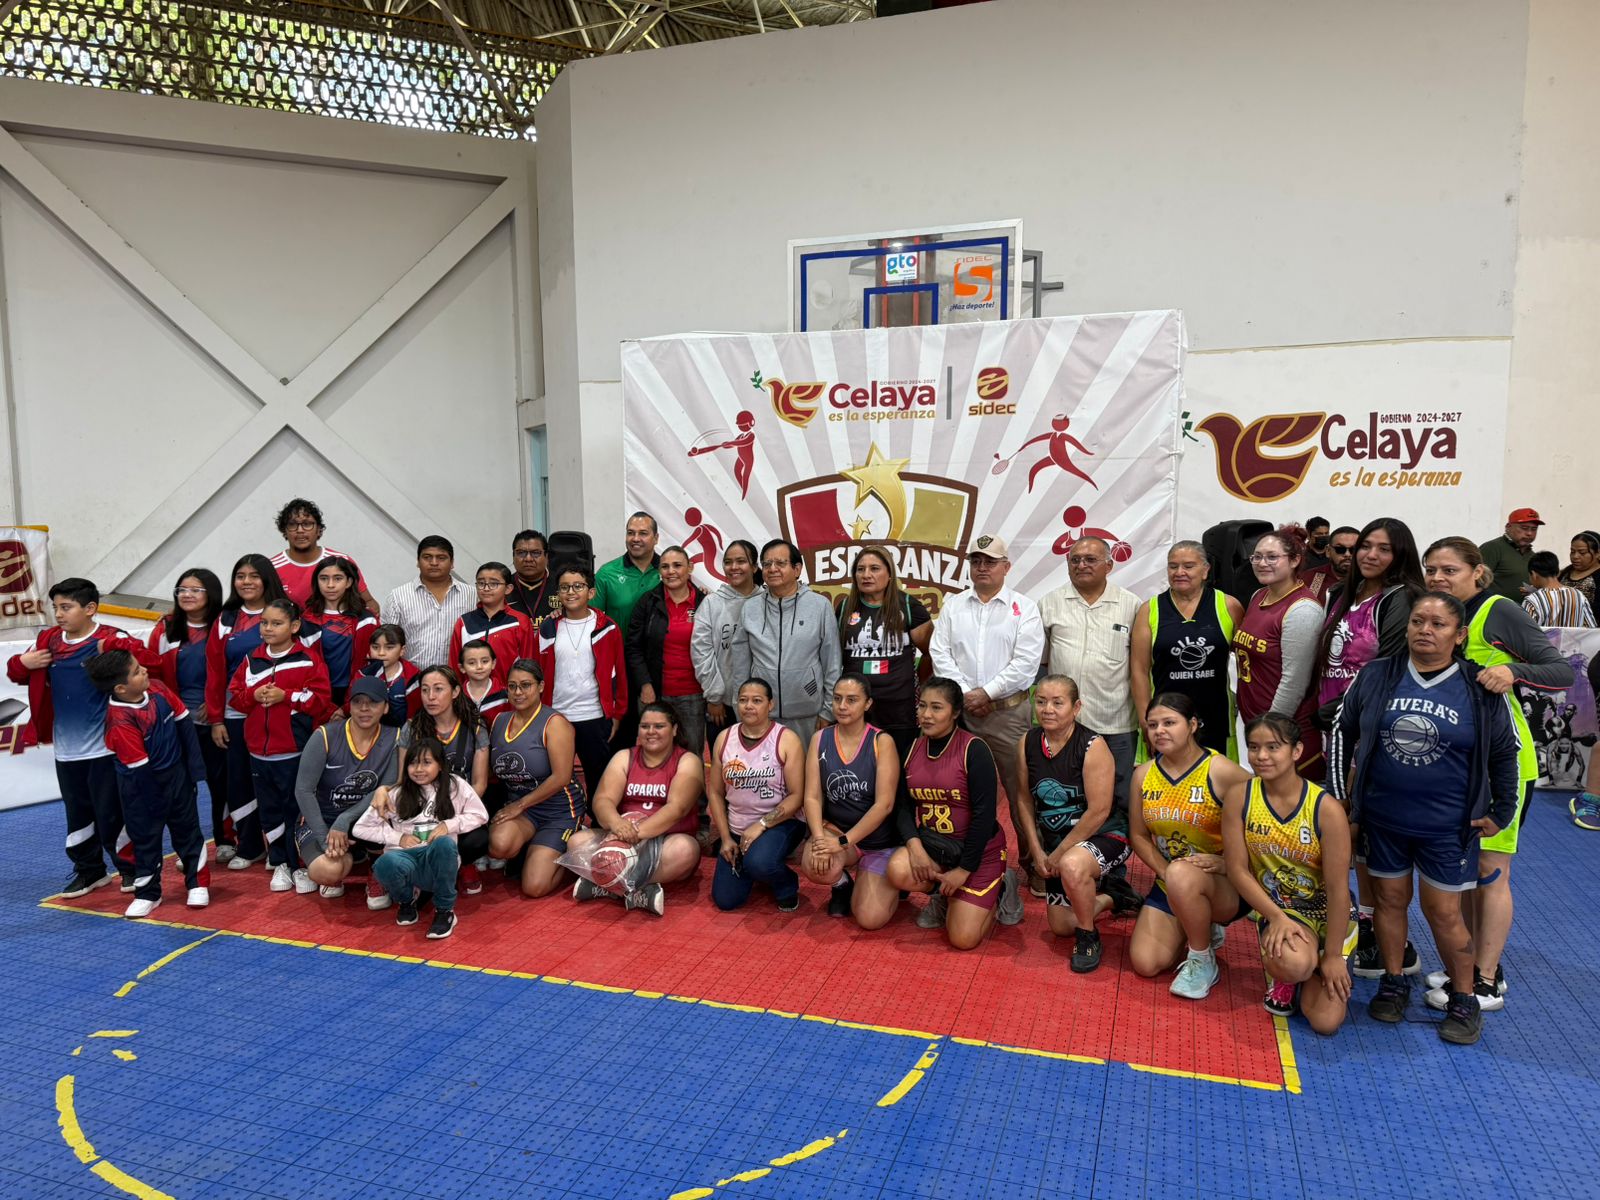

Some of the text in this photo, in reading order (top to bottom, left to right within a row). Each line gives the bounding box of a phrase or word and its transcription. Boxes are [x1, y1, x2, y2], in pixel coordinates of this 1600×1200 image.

[887, 254, 917, 275] gto
[966, 302, 996, 311] deporte!
[829, 381, 936, 411] Celaya
[828, 409, 936, 423] es la esperanza
[968, 402, 1017, 416] sidec
[1380, 412, 1463, 424] GOBIERNO 2024-2027
[1320, 411, 1458, 470] Celaya
[1329, 466, 1463, 490] es la esperanza
[1170, 636, 1215, 656] GILSA
[1169, 669, 1215, 680] QUIEN SABE
[626, 783, 666, 798] SPARKS
[1299, 826, 1312, 845] 6
